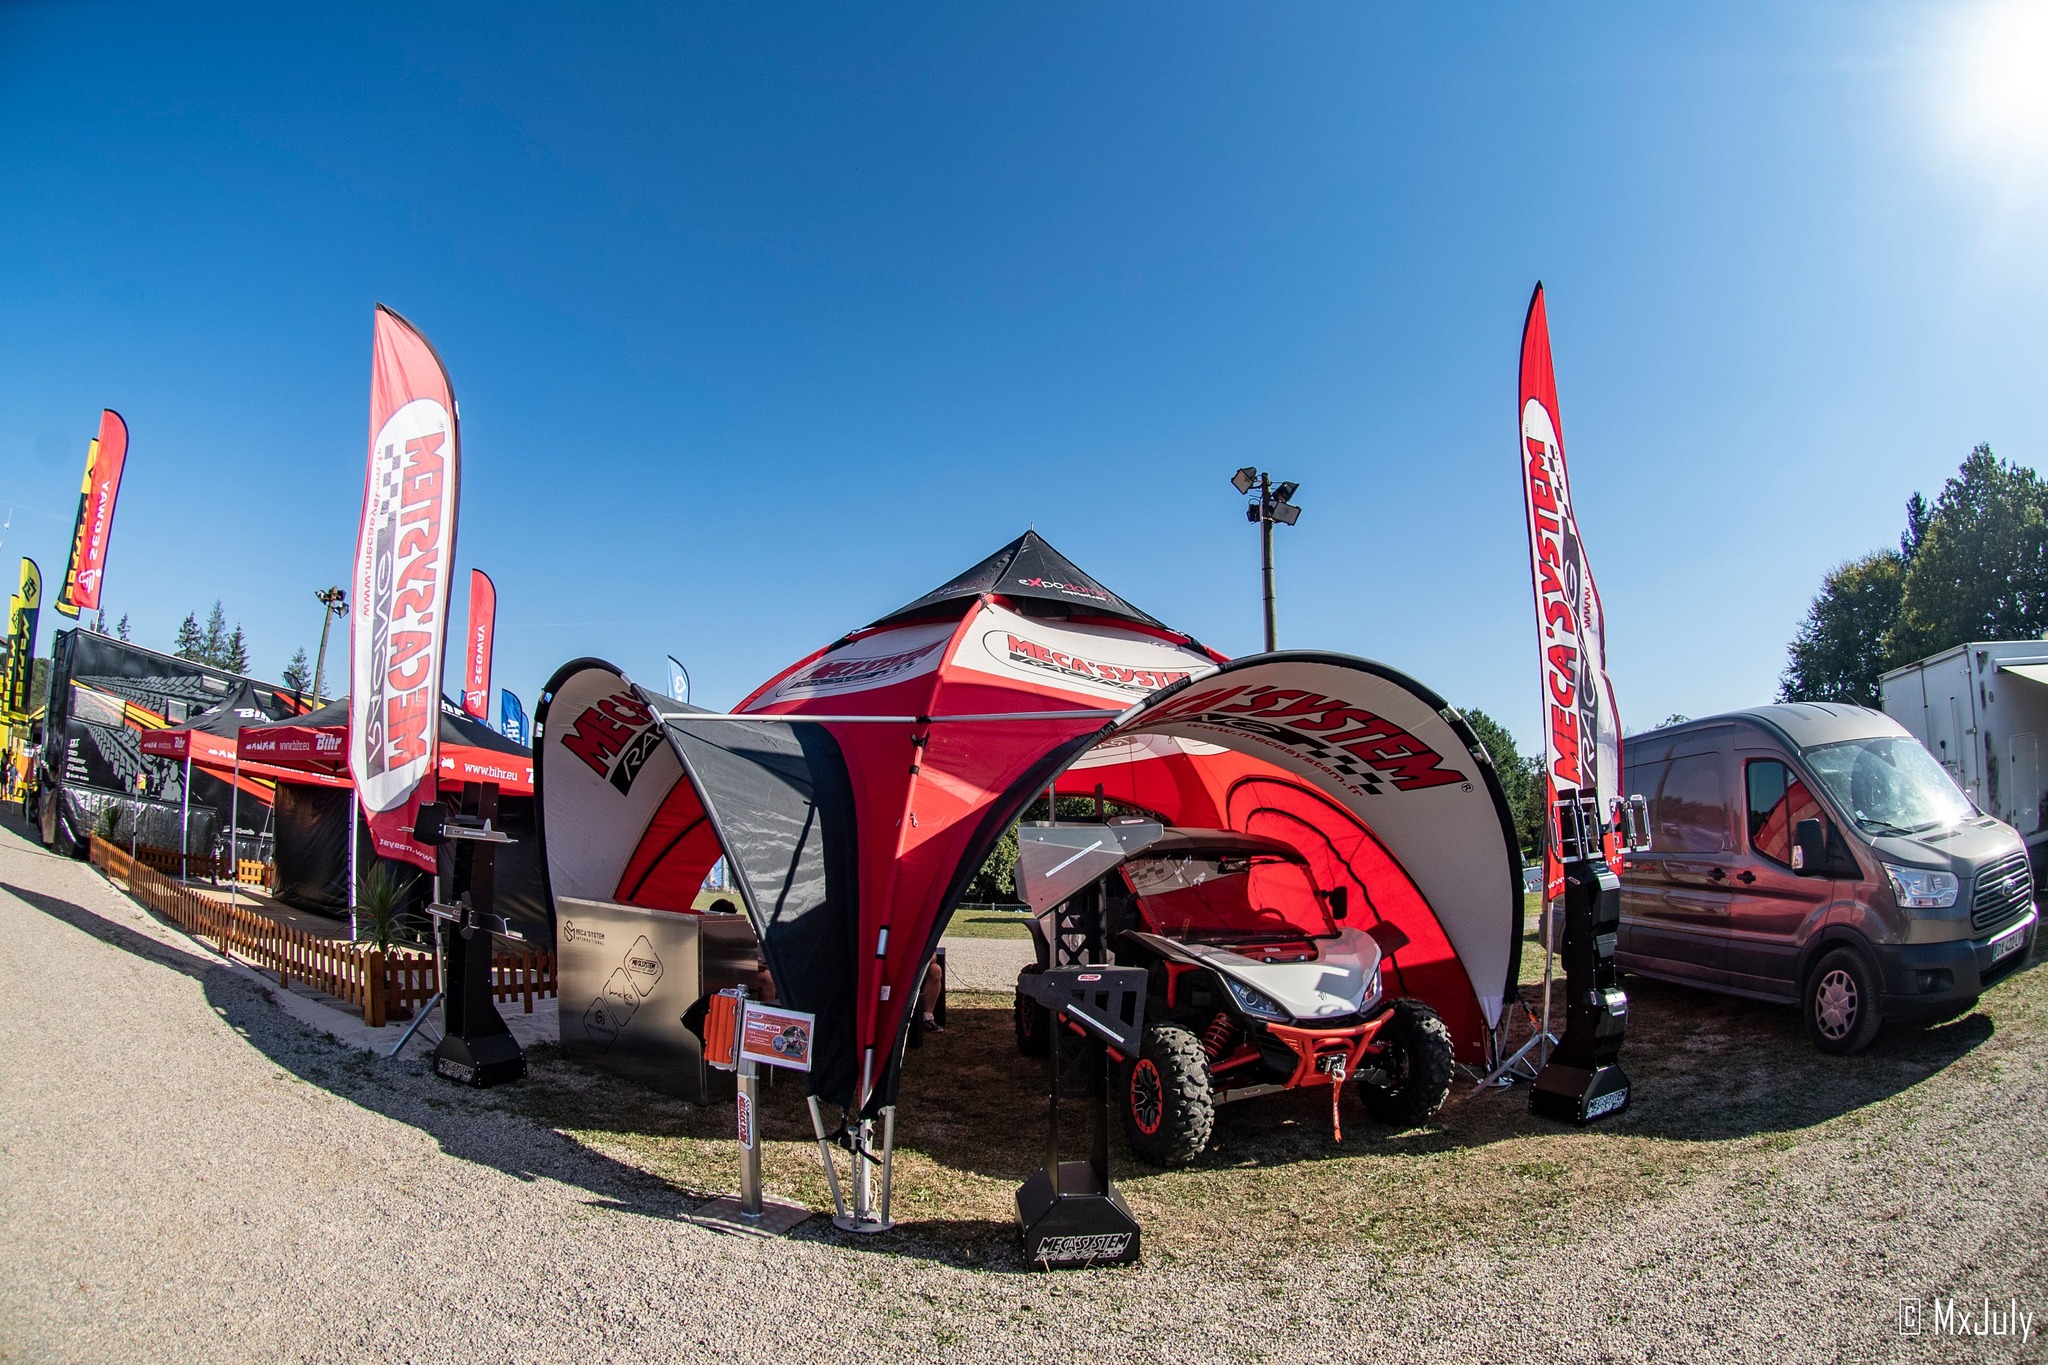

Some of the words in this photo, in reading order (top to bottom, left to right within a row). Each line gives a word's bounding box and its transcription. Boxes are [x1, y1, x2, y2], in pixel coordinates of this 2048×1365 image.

[1526, 436, 1581, 786] MECA'SYSTEM
[1007, 633, 1190, 689] MECA'SYSTE
[315, 733, 342, 751] Bihr
[1186, 722, 1364, 797] www.mecasystem.fr
[464, 763, 518, 781] www.bihr.eu
[765, 1025, 780, 1034] KTM
